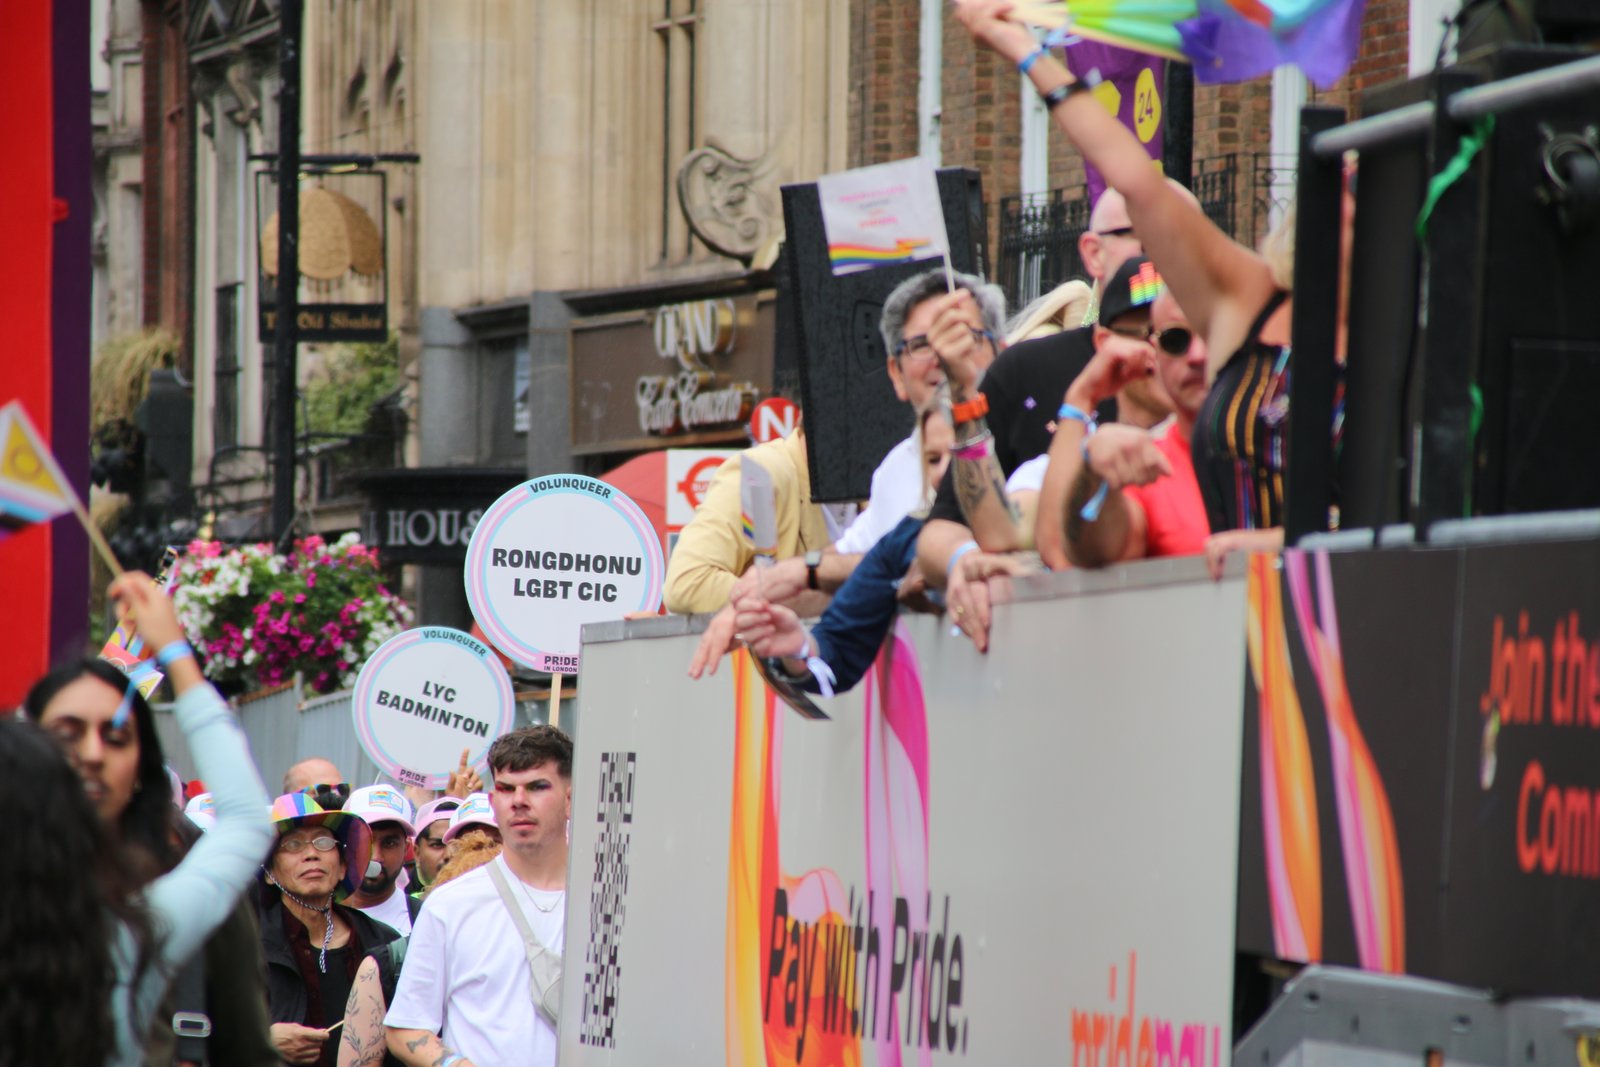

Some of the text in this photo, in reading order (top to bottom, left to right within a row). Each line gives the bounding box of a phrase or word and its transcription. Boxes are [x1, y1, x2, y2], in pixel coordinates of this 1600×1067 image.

[1138, 88, 1154, 124] 24
[759, 405, 795, 441] N
[530, 478, 611, 499] VOLUNQUEER
[387, 509, 484, 547] HOUS
[492, 548, 642, 576] RONGDHONU
[513, 578, 618, 603] LGBT CIC
[423, 630, 487, 657] VOLUNQUEER
[1480, 607, 1600, 729] Join the
[421, 680, 457, 704] LYC
[376, 690, 490, 738] BADMINTON
[764, 885, 968, 1065] Pay with Pride.
